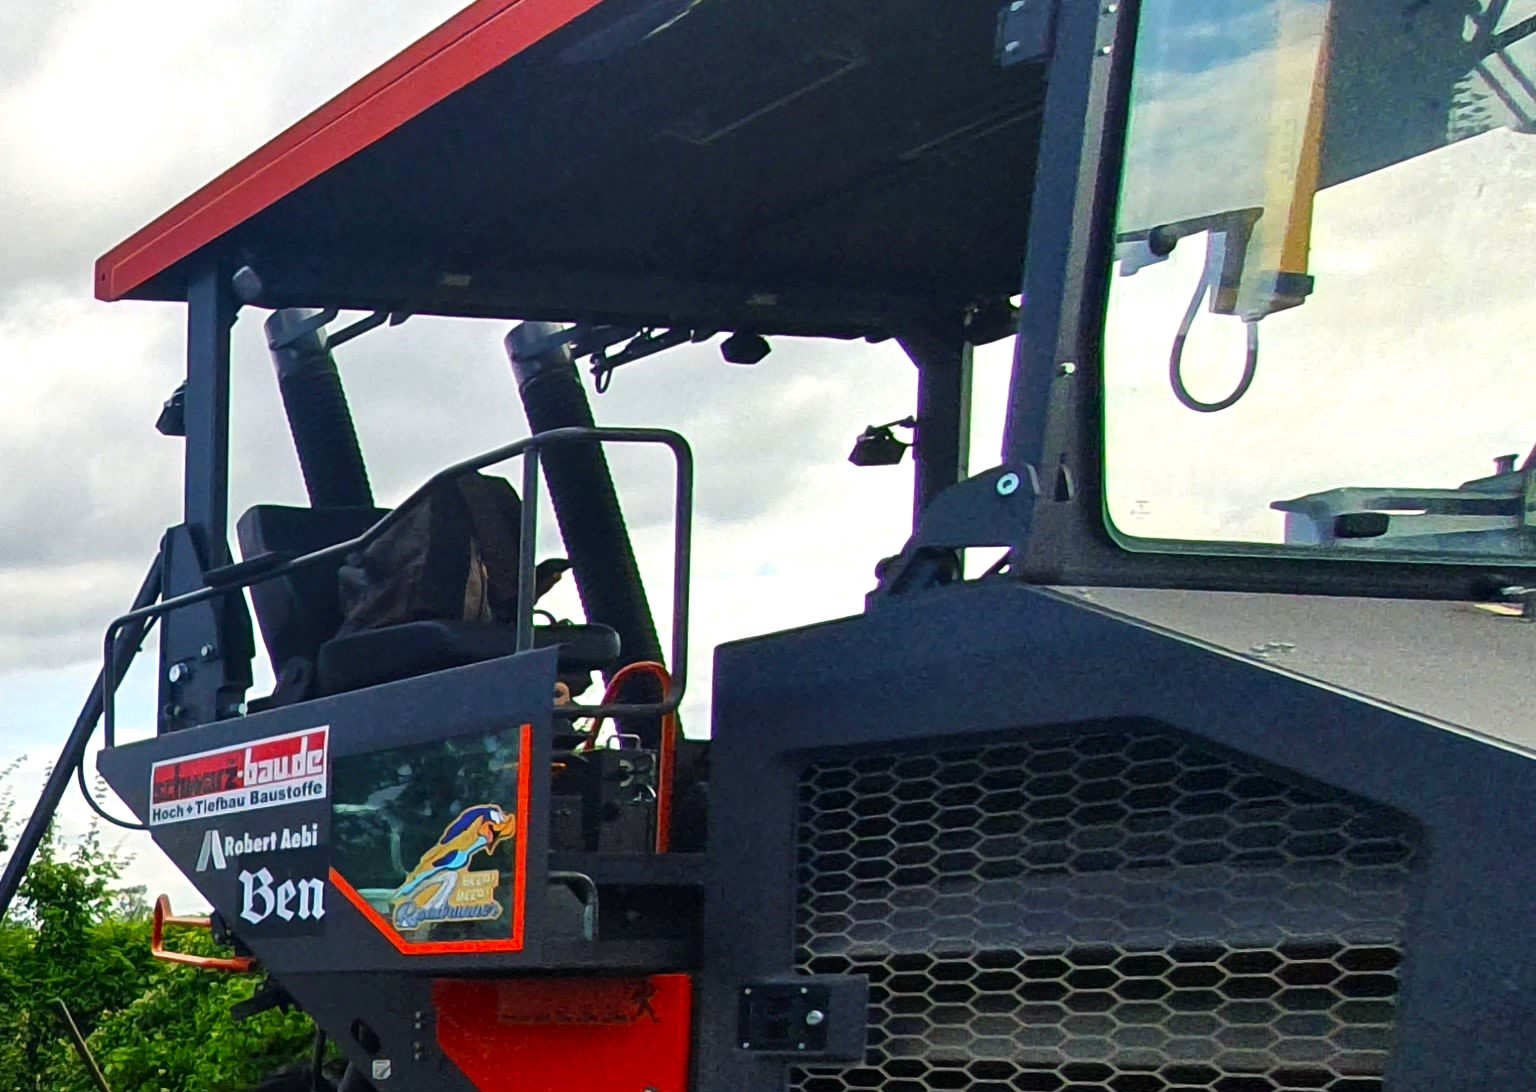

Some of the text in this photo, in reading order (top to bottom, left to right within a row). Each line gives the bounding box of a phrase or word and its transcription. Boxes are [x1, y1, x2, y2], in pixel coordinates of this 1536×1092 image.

[152, 806, 184, 822] Hoch
[195, 796, 245, 815] Tiefbau
[250, 781, 323, 804] Baustoffe
[225, 823, 318, 856] Robert Aebi
[238, 867, 325, 924] Ben
